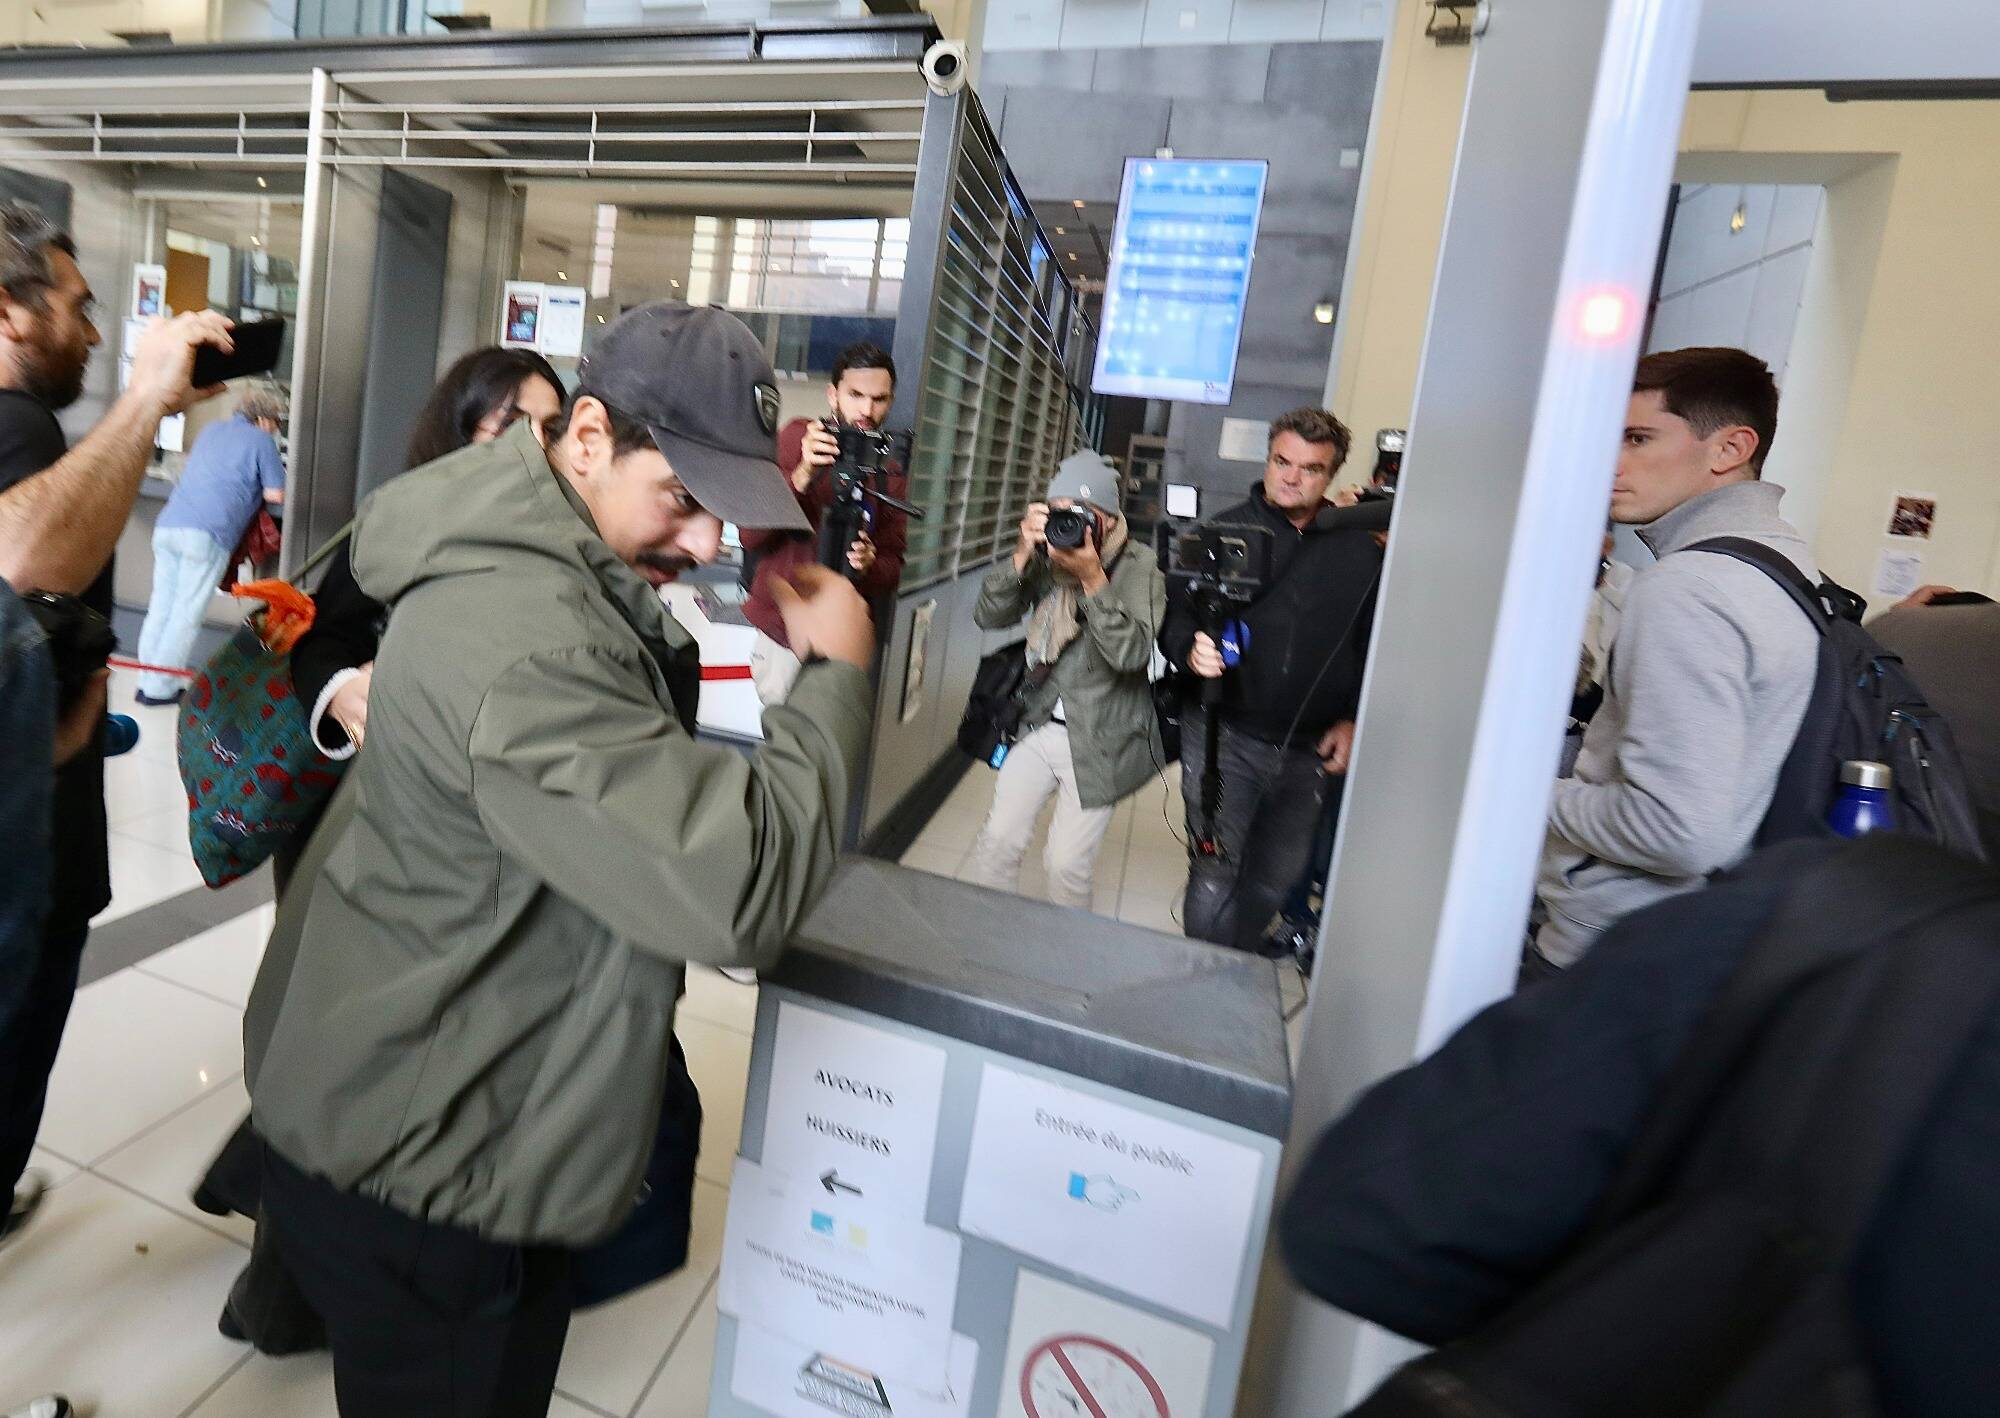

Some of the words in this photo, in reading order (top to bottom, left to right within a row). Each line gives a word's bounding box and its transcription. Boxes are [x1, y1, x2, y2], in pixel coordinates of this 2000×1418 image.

[814, 1068, 895, 1107] AVOCATS
[806, 1112, 892, 1156] HUISSIERS
[1034, 1106, 1097, 1144] Entrée
[1101, 1130, 1127, 1153] du
[1131, 1143, 1195, 1176] public
